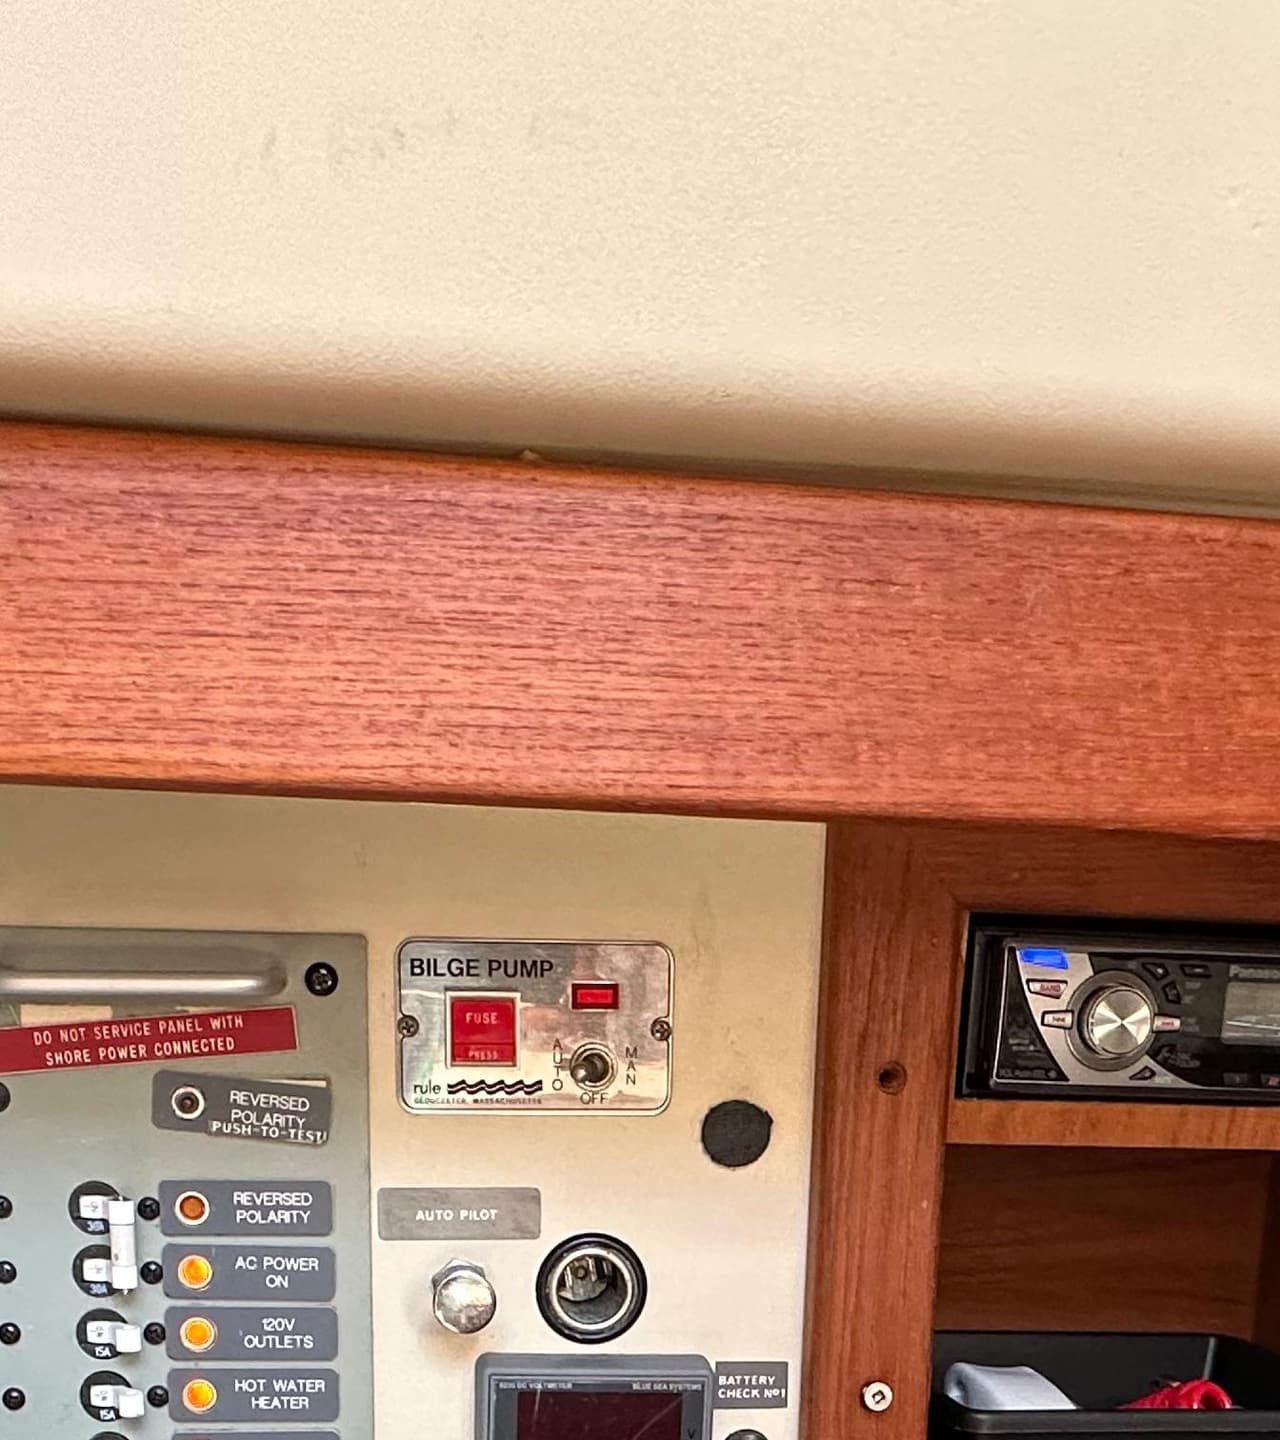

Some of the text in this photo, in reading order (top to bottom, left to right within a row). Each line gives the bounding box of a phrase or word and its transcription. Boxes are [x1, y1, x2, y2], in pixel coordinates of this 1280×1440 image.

[409, 957, 554, 978] BILGE PUMP
[465, 1012, 497, 1025] FUSE
[33, 1014, 244, 1046] DO NOT SERVICE PANEL WITH
[45, 1037, 235, 1066] SHORE POWER CONNECTED
[467, 1050, 499, 1061] PRESS
[552, 1038, 563, 1091] AUTO
[624, 1046, 638, 1086] MAN
[413, 1079, 441, 1095] rule
[229, 1089, 310, 1112] REVERSED
[580, 1091, 609, 1105] OFF
[230, 1108, 306, 1128] POLARITY
[232, 1192, 312, 1207] REVERSED
[236, 1210, 311, 1225] POLARITY
[415, 1208, 498, 1221] AUTO PILOT
[234, 1257, 319, 1271] AC POWER
[266, 1274, 289, 1289] ON
[261, 1318, 296, 1332] 120V
[243, 1335, 314, 1349] OUTLETS
[94, 1346, 112, 1358] 15A
[234, 1379, 326, 1394] HOT WATER
[718, 1375, 776, 1386] BATTERY
[718, 1387, 761, 1399] CHECK
[251, 1396, 310, 1410] HEATER
[99, 1409, 116, 1421] 15A
